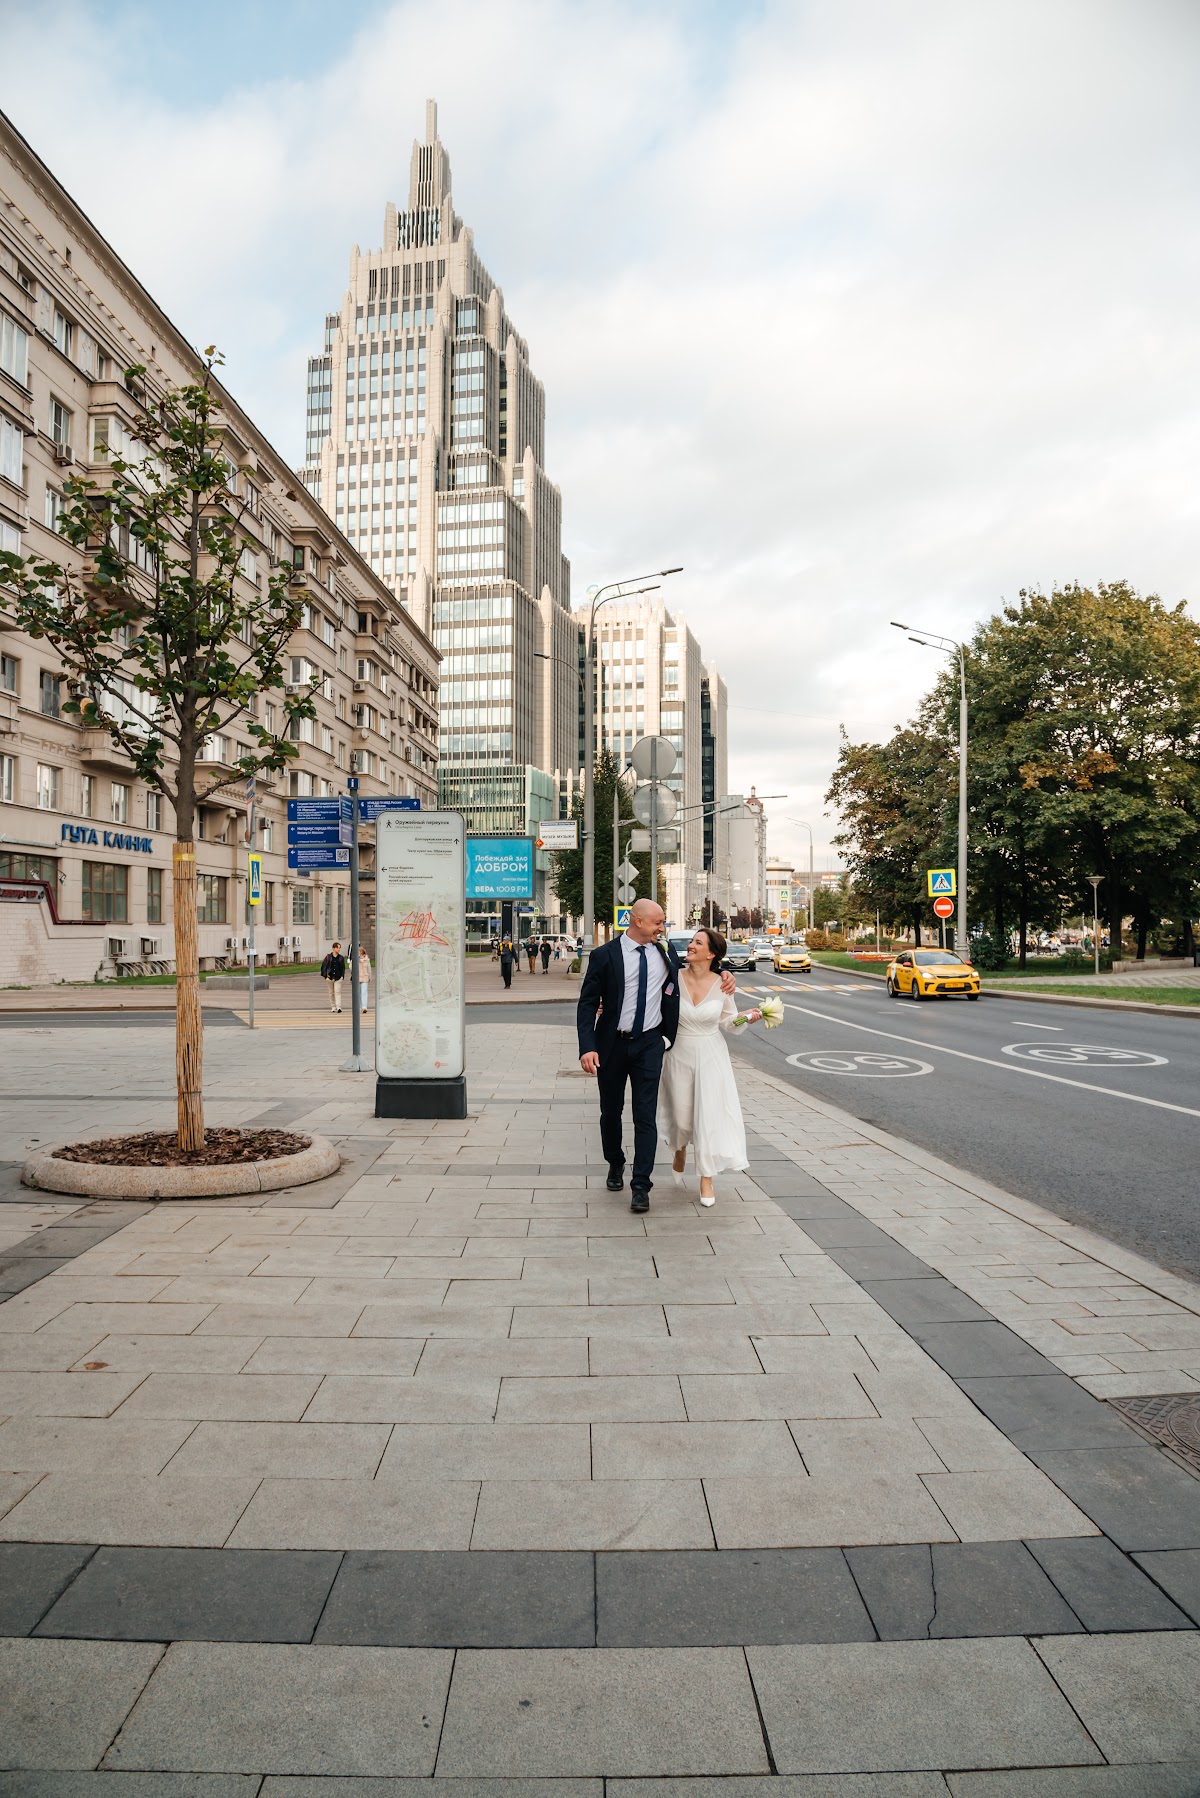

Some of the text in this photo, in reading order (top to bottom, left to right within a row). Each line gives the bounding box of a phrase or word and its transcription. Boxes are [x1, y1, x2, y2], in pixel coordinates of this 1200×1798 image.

[61, 823, 153, 854] ГУТА КЛИНИК
[475, 854, 513, 862] Побеждай
[475, 862, 528, 873] ДОБРОМ
[475, 885, 528, 893] ВЕРА 100.9 FM
